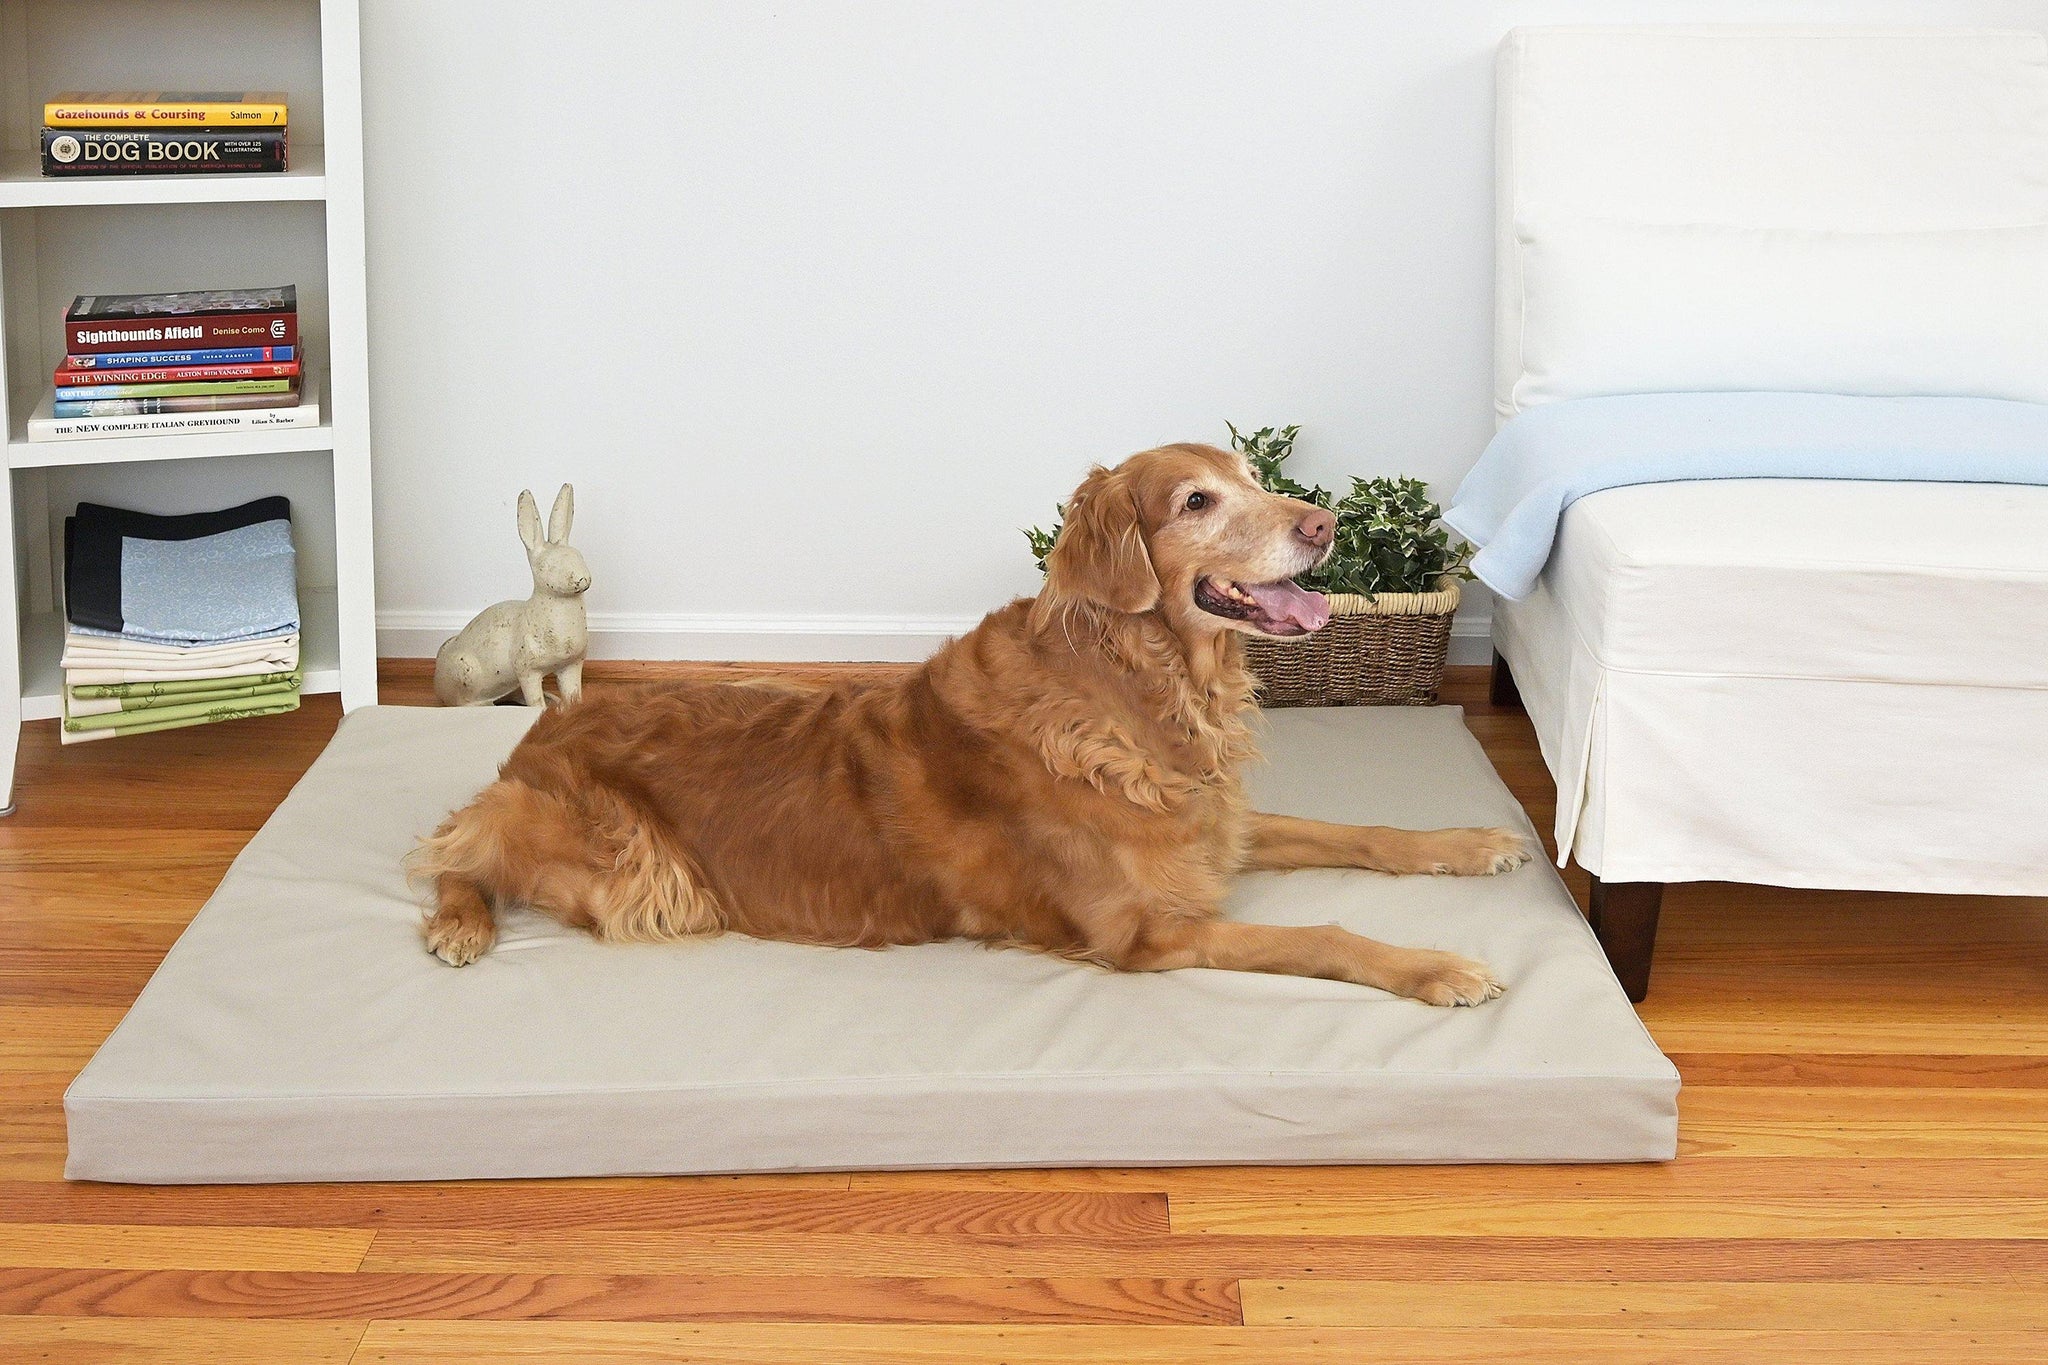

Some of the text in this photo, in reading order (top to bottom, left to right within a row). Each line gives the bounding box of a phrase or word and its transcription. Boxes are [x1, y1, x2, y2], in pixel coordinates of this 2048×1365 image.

[55, 109, 206, 120] Gazehounds & Coursing
[230, 110, 262, 120] Salmon
[84, 142, 140, 162] DOG
[148, 142, 220, 161] BOOK
[76, 326, 203, 344] Sighthounds Afield
[212, 328, 240, 336] Denise
[107, 354, 192, 364] SHAPING SUCCESS
[70, 372, 167, 384] THE WINNING EDGE
[76, 424, 100, 432] NEW
[102, 423, 149, 431] COMPLETE
[187, 418, 241, 426] GREYHOUND
